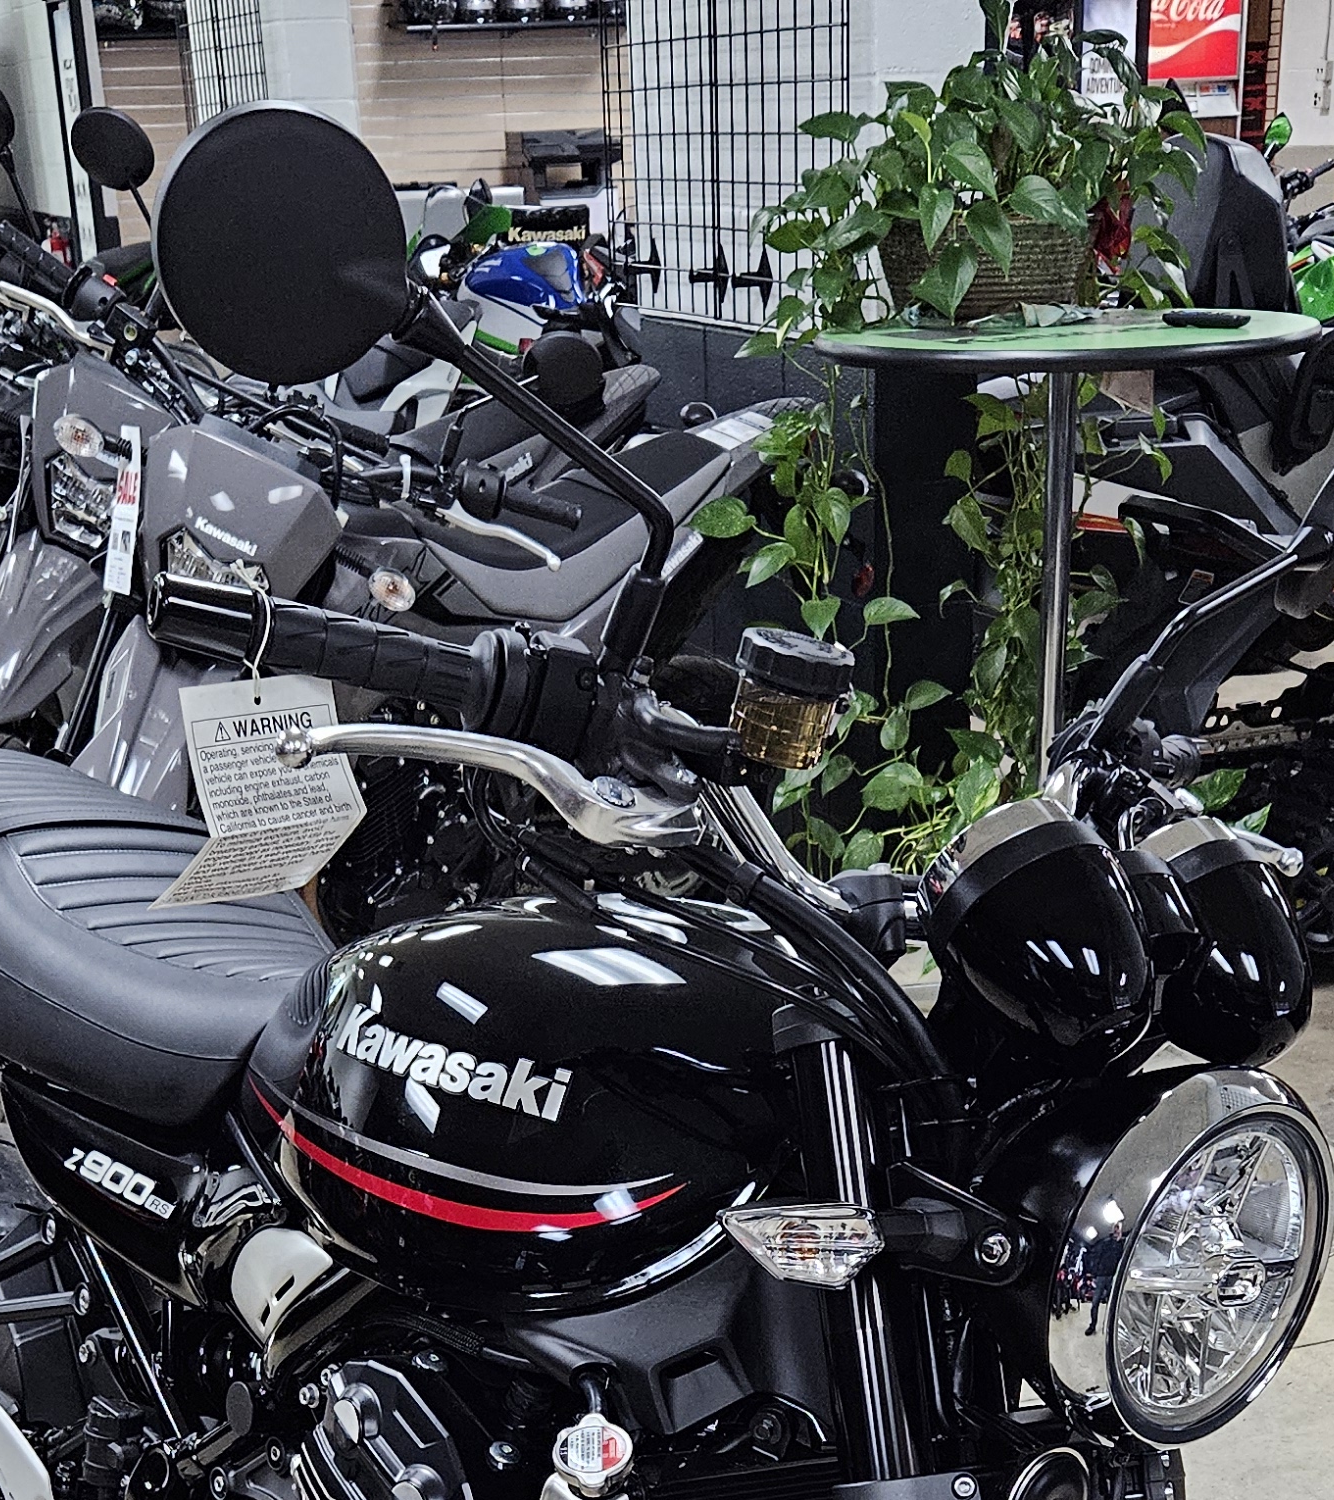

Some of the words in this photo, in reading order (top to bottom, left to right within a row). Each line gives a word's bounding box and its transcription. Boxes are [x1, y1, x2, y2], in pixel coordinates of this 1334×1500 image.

[508, 224, 586, 242] Kawasaki
[116, 470, 139, 506] SALE
[194, 516, 258, 557] Kawasaki
[233, 711, 313, 738] WARNING
[200, 747, 238, 761] Operating,
[203, 765, 208, 773] a
[210, 758, 248, 773] passenger
[251, 753, 277, 766] vehicle
[205, 772, 232, 786] vehicle
[233, 771, 247, 782] can
[249, 766, 277, 780] expose
[209, 783, 243, 798] including
[244, 780, 270, 794] engine
[304, 770, 331, 782] carbon
[294, 786, 308, 795] and
[216, 808, 239, 821] which
[240, 807, 253, 817] are
[254, 804, 280, 816] known
[281, 802, 289, 811] to
[289, 799, 302, 809] the
[303, 795, 324, 807] State
[325, 793, 333, 803] of
[219, 819, 257, 834] California
[258, 817, 266, 827] to
[267, 813, 291, 826] cause
[292, 810, 317, 822] cancer
[318, 806, 335, 817] and
[335, 801, 352, 815] birth
[336, 1002, 573, 1122] Kawasaki
